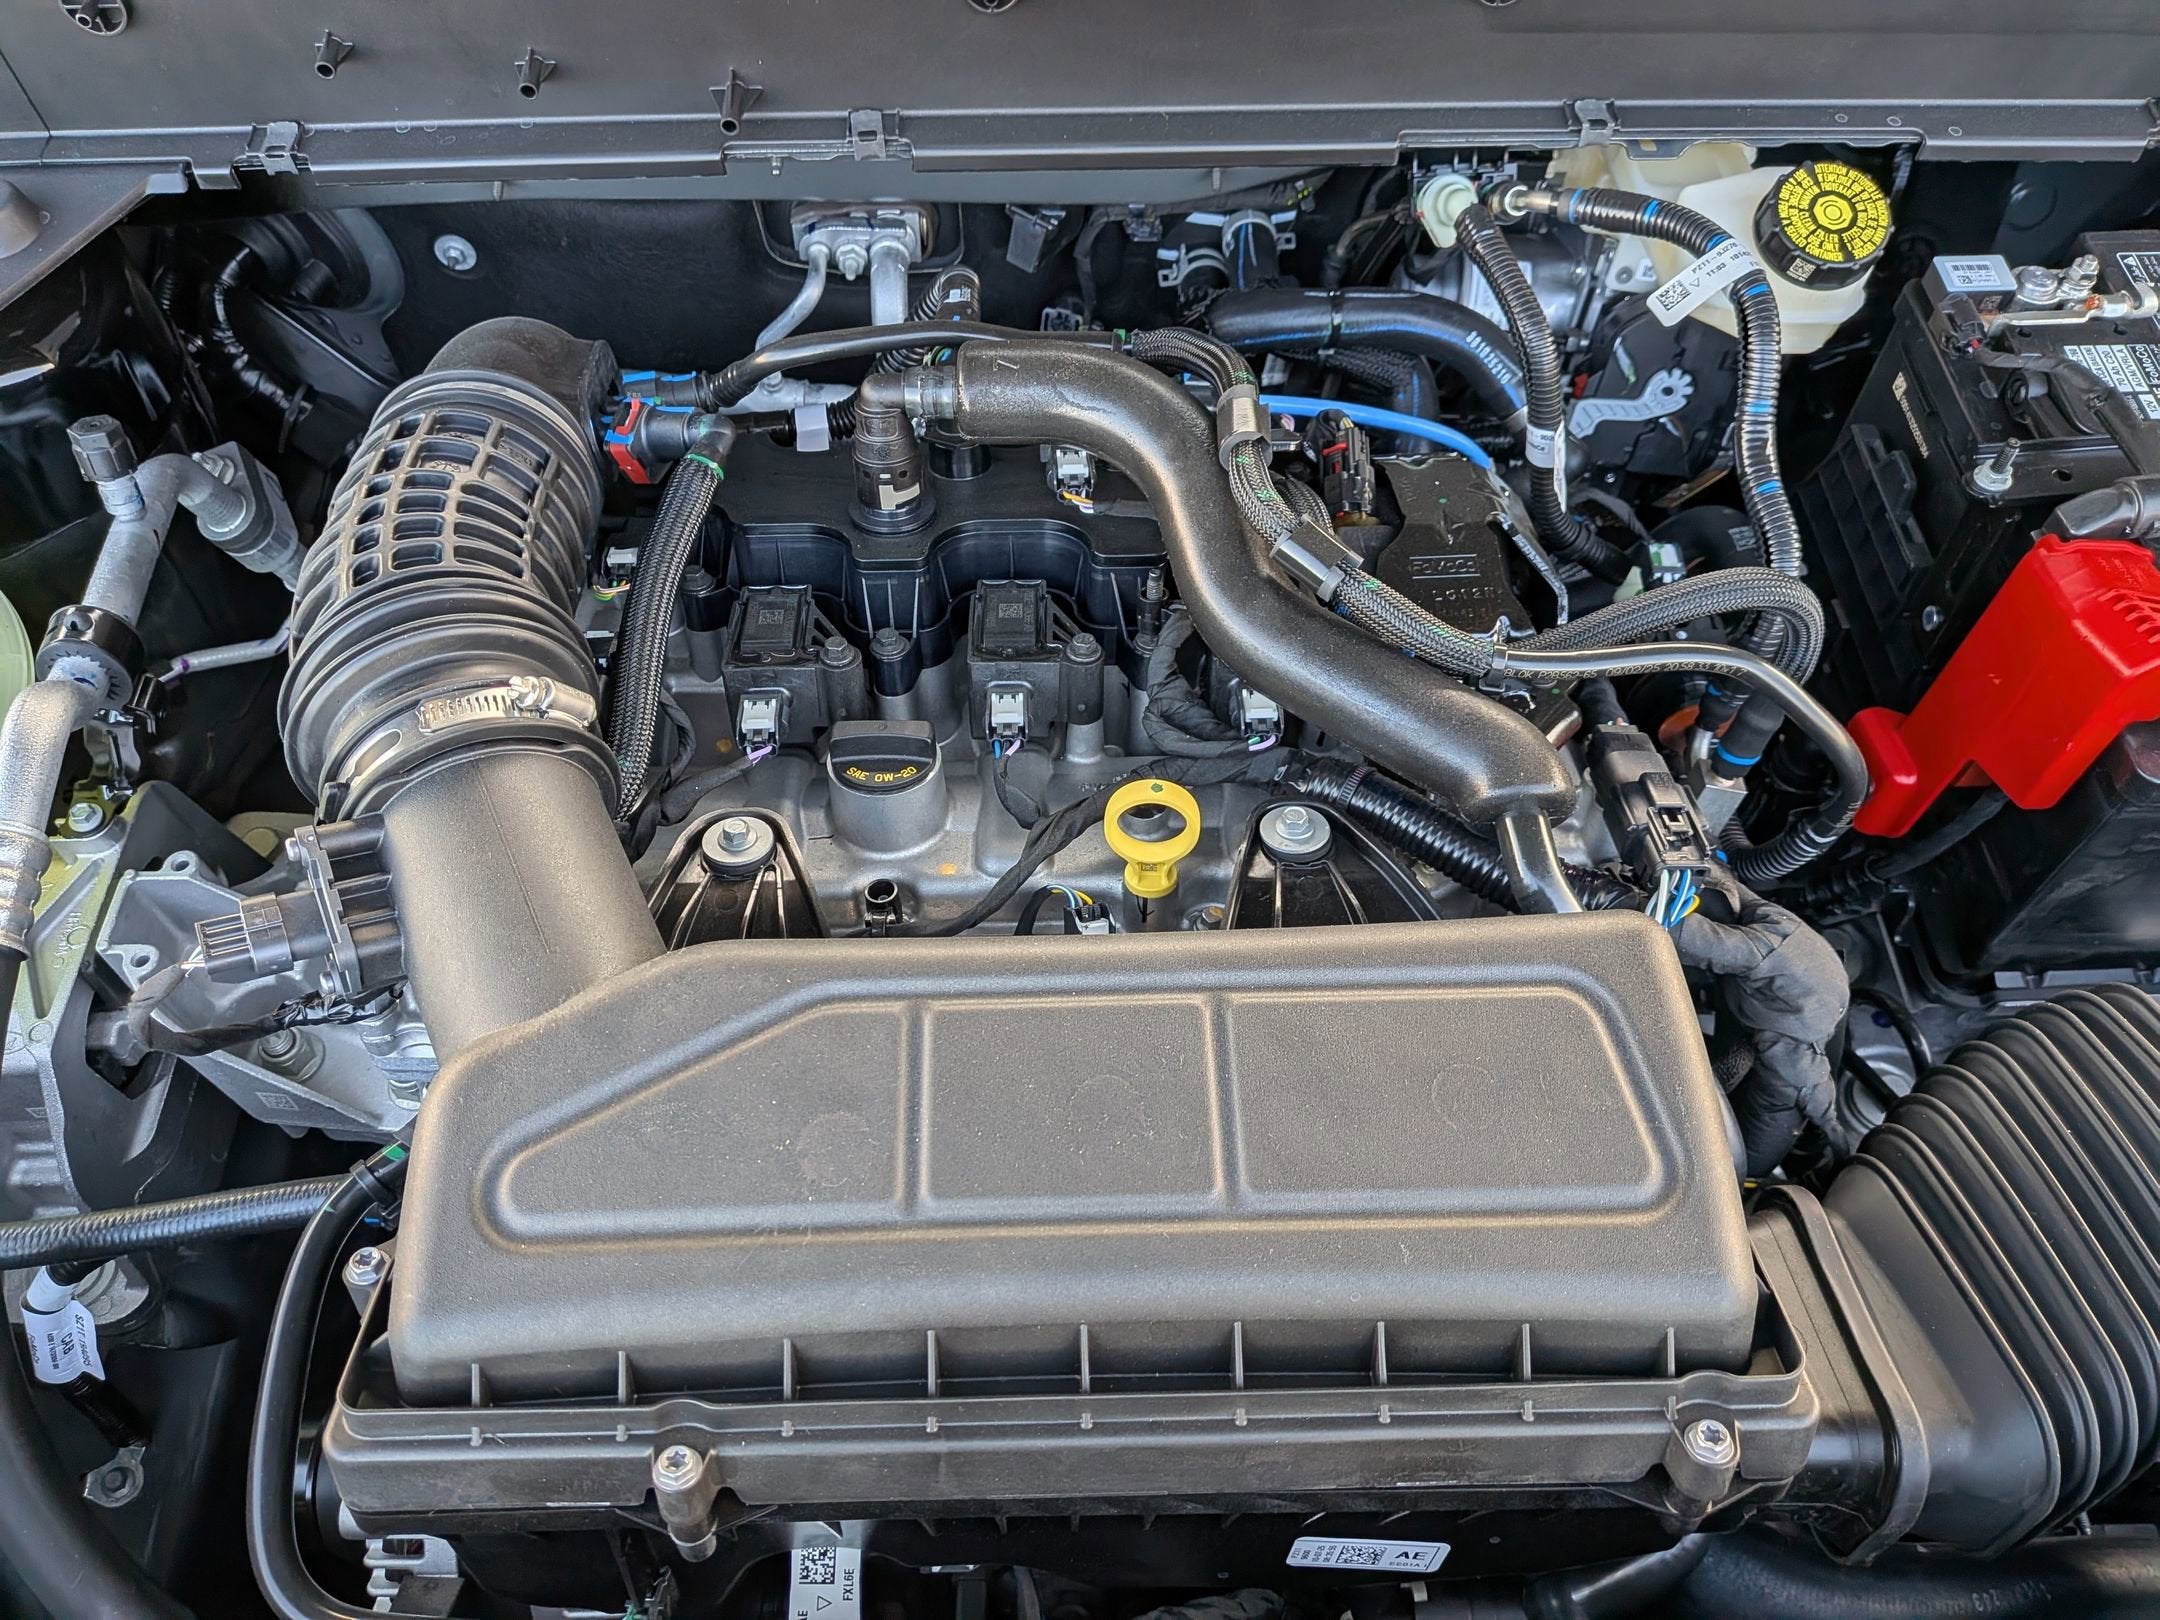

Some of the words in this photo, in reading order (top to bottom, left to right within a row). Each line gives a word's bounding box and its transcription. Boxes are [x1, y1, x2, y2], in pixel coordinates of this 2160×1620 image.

[1791, 168, 1807, 181] DOT
[1812, 163, 1848, 175] ATTENTION
[1787, 176, 1798, 185] 4
[1798, 176, 1813, 189] CAP
[1847, 168, 1877, 192] NETTOYER
[1779, 181, 1794, 200] FLUID
[1788, 184, 1804, 207] BEFORE
[1798, 183, 1820, 209] WARNING
[1818, 181, 1856, 198] PROVENANT
[1859, 189, 1872, 200] DU
[1870, 190, 1883, 200] LE
[1778, 200, 1789, 217] FROM
[1864, 198, 1878, 219] LIQUIDE
[1875, 199, 1888, 227] BOUCHON
[1788, 207, 1809, 238] REMOVING
[1799, 211, 1817, 232] CLEAN
[1866, 219, 1878, 228] DE
[1783, 224, 1807, 248] SEALED
[1806, 234, 1821, 247] USE
[1813, 228, 1839, 243] FILLER
[1858, 226, 1875, 243] FREIN
[1870, 226, 1887, 245] AVANT
[1821, 241, 1839, 252] ONLY
[1845, 241, 1853, 250] 4
[1850, 237, 1864, 249] DOT
[1804, 243, 1843, 261] CONTAINER
[2101, 350, 2115, 365] C20
[2135, 345, 2160, 384] FoMoCo
[2110, 365, 2121, 376] Ah
[2116, 348, 2145, 388] AGM/VRLA
[2116, 377, 2127, 387] 70
[2143, 400, 2159, 413] 12V
[847, 767, 869, 780] SAE
[874, 766, 917, 782] 0W-20
[61, 1332, 75, 1355] CAB
[1394, 1551, 1428, 1563] AE
[843, 1568, 855, 1601] FXL6E
